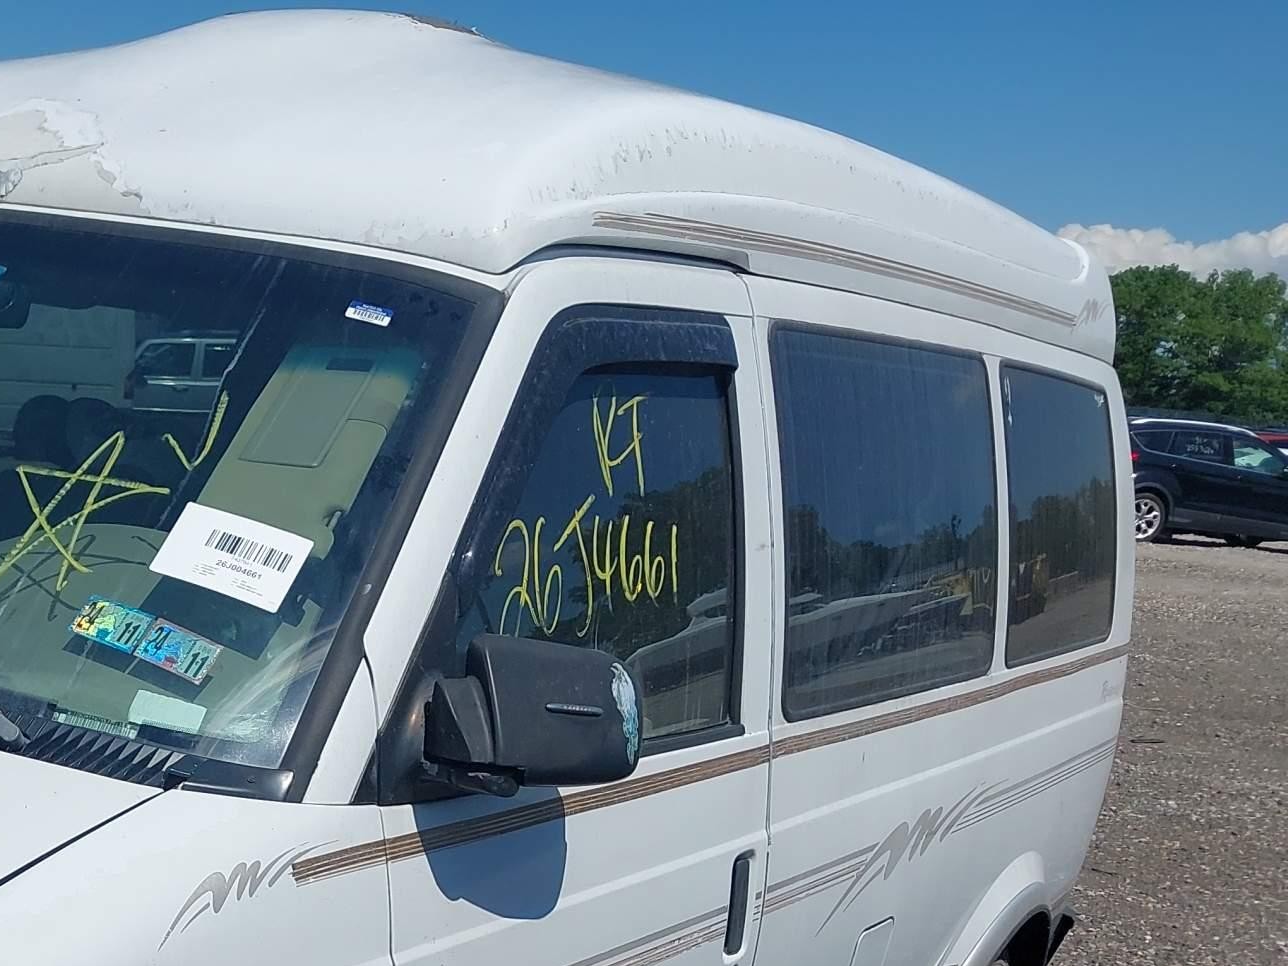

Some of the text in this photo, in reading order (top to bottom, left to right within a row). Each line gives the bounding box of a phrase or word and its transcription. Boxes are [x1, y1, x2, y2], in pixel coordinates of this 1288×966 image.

[494, 494, 679, 641] 26J4661
[116, 621, 142, 645] 11
[143, 626, 210, 678] 24 11
